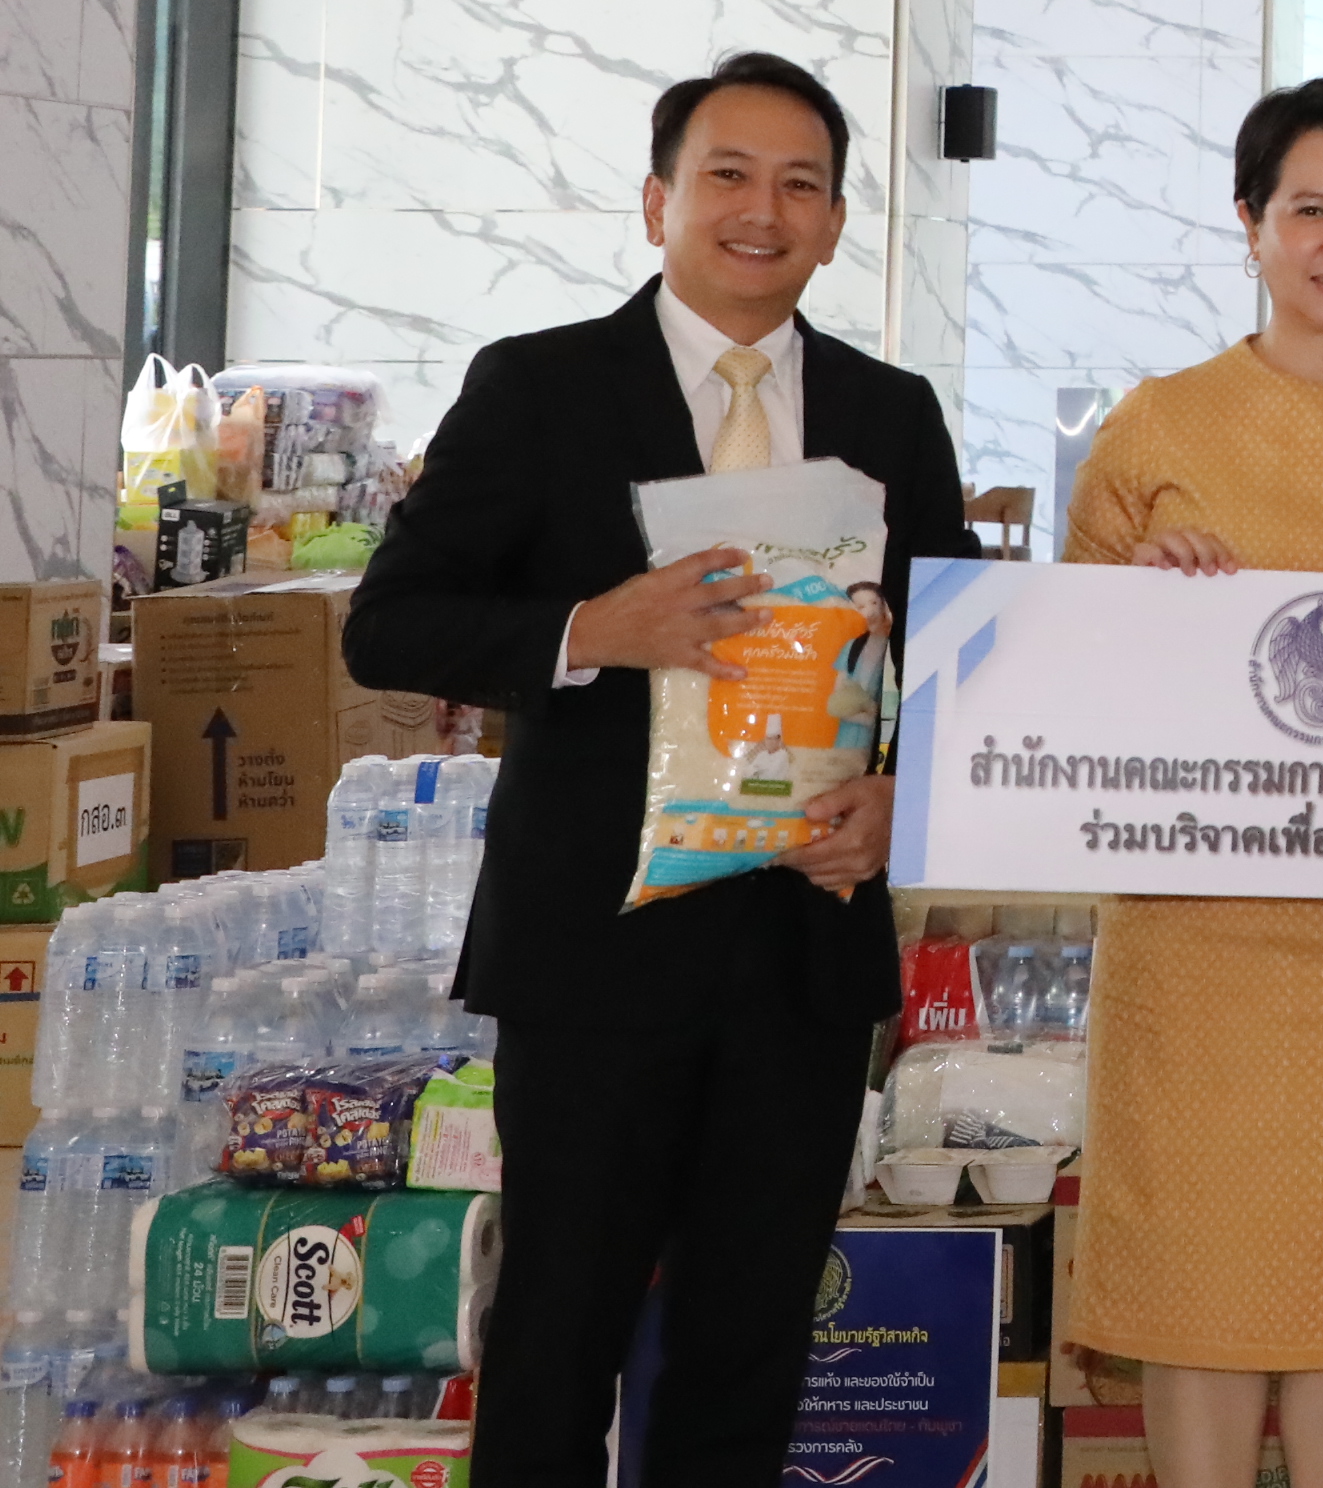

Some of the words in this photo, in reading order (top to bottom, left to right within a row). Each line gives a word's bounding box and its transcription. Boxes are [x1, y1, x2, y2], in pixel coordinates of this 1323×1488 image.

[238, 771, 294, 787] ห้ามโยน
[918, 986, 967, 1030] เพิ่ม
[193, 1262, 204, 1277] 24
[273, 1255, 282, 1282] Clean
[291, 1236, 330, 1327] Scott
[269, 1285, 279, 1309] Care
[812, 1322, 929, 1347] รนโยบายรัฐวิสาหกิจ
[802, 1372, 841, 1388] ารแห้ง
[844, 1371, 935, 1388] และของใช้จำเป็น
[854, 1398, 929, 1412] และประชาชน
[788, 1439, 863, 1453] รวงการคลัง
